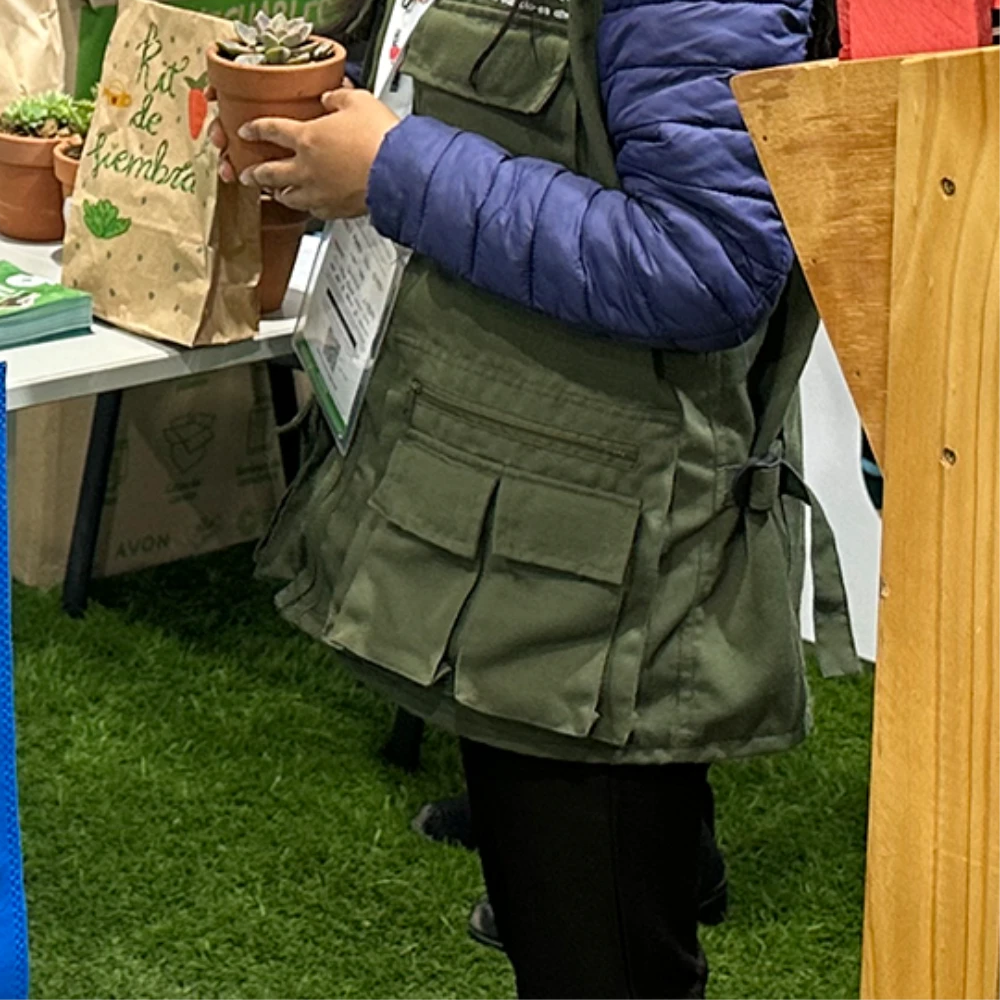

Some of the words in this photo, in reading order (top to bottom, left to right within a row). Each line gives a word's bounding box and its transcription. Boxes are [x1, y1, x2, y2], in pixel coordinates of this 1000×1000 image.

[135, 21, 190, 99] Kit
[129, 94, 163, 136] de
[116, 533, 171, 559] AVON
